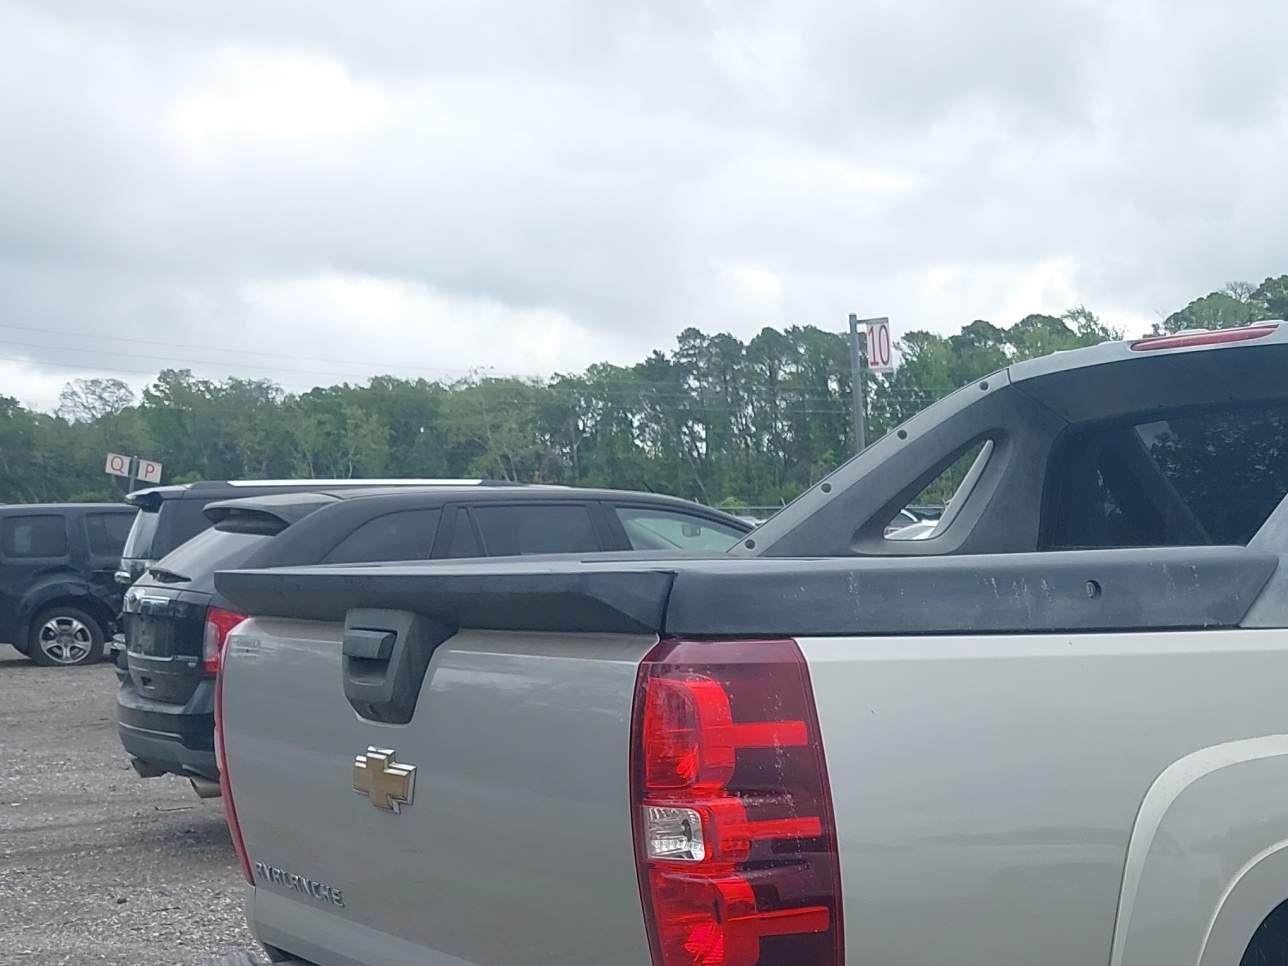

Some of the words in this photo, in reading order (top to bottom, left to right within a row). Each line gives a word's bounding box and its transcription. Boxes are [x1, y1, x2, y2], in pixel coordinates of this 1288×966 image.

[868, 324, 890, 367] 10
[110, 455, 126, 475] Q
[144, 463, 155, 479] P
[255, 861, 344, 908] AVALANCHE
